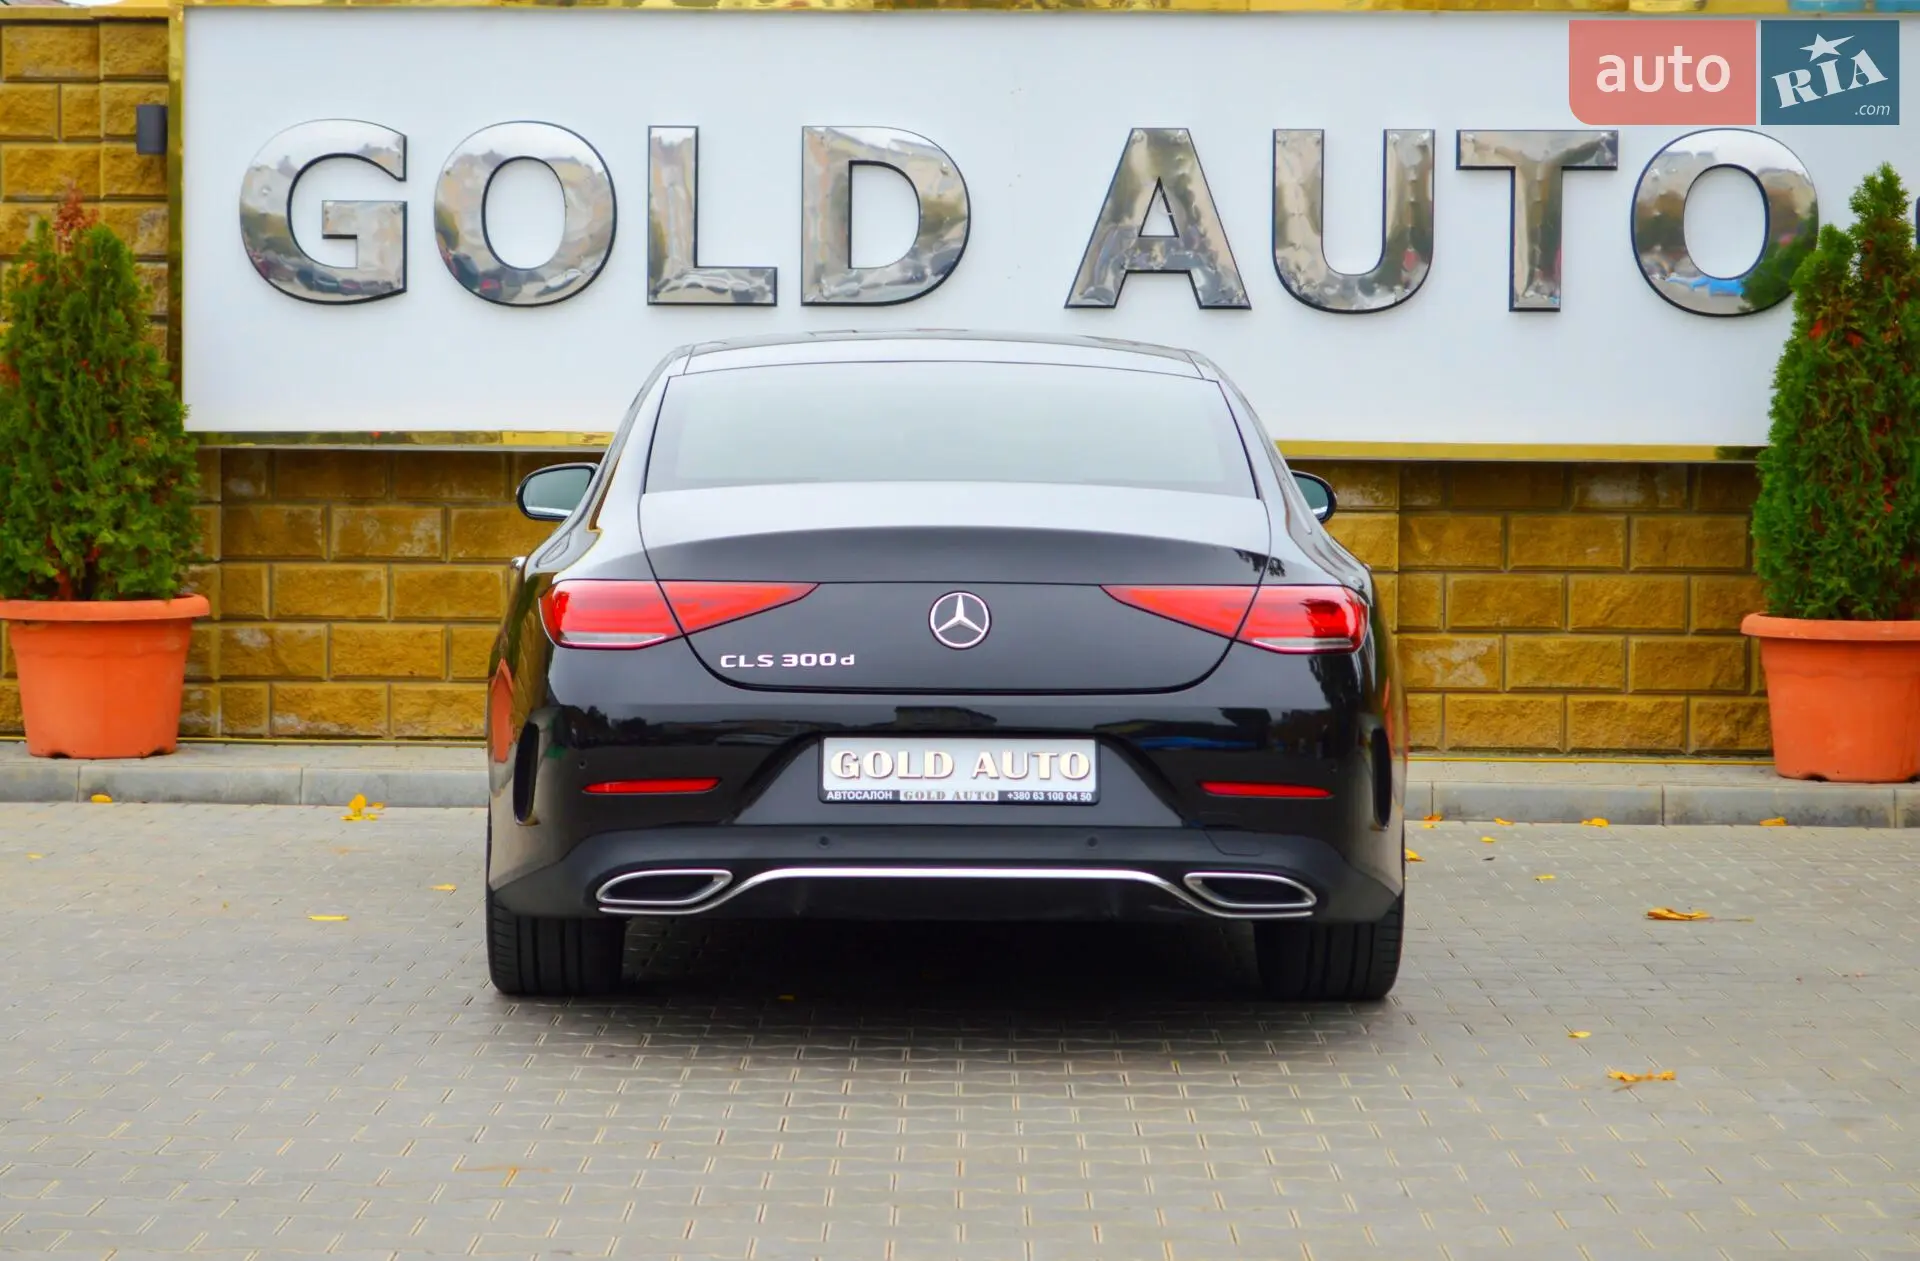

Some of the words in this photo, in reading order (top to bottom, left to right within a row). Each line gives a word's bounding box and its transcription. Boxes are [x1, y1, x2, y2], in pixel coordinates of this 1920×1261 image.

[239, 118, 971, 307] GOLD
[1064, 127, 1820, 318] AUTO
[720, 654, 775, 668] CLS
[830, 750, 955, 780] GOLD
[971, 750, 1091, 780] AUTO
[826, 790, 893, 801] АВТОСАЛОН
[903, 790, 946, 801] GOLD
[952, 790, 996, 801] AUTO
[1007, 791, 1031, 801] +380
[1046, 791, 1064, 801] 100
